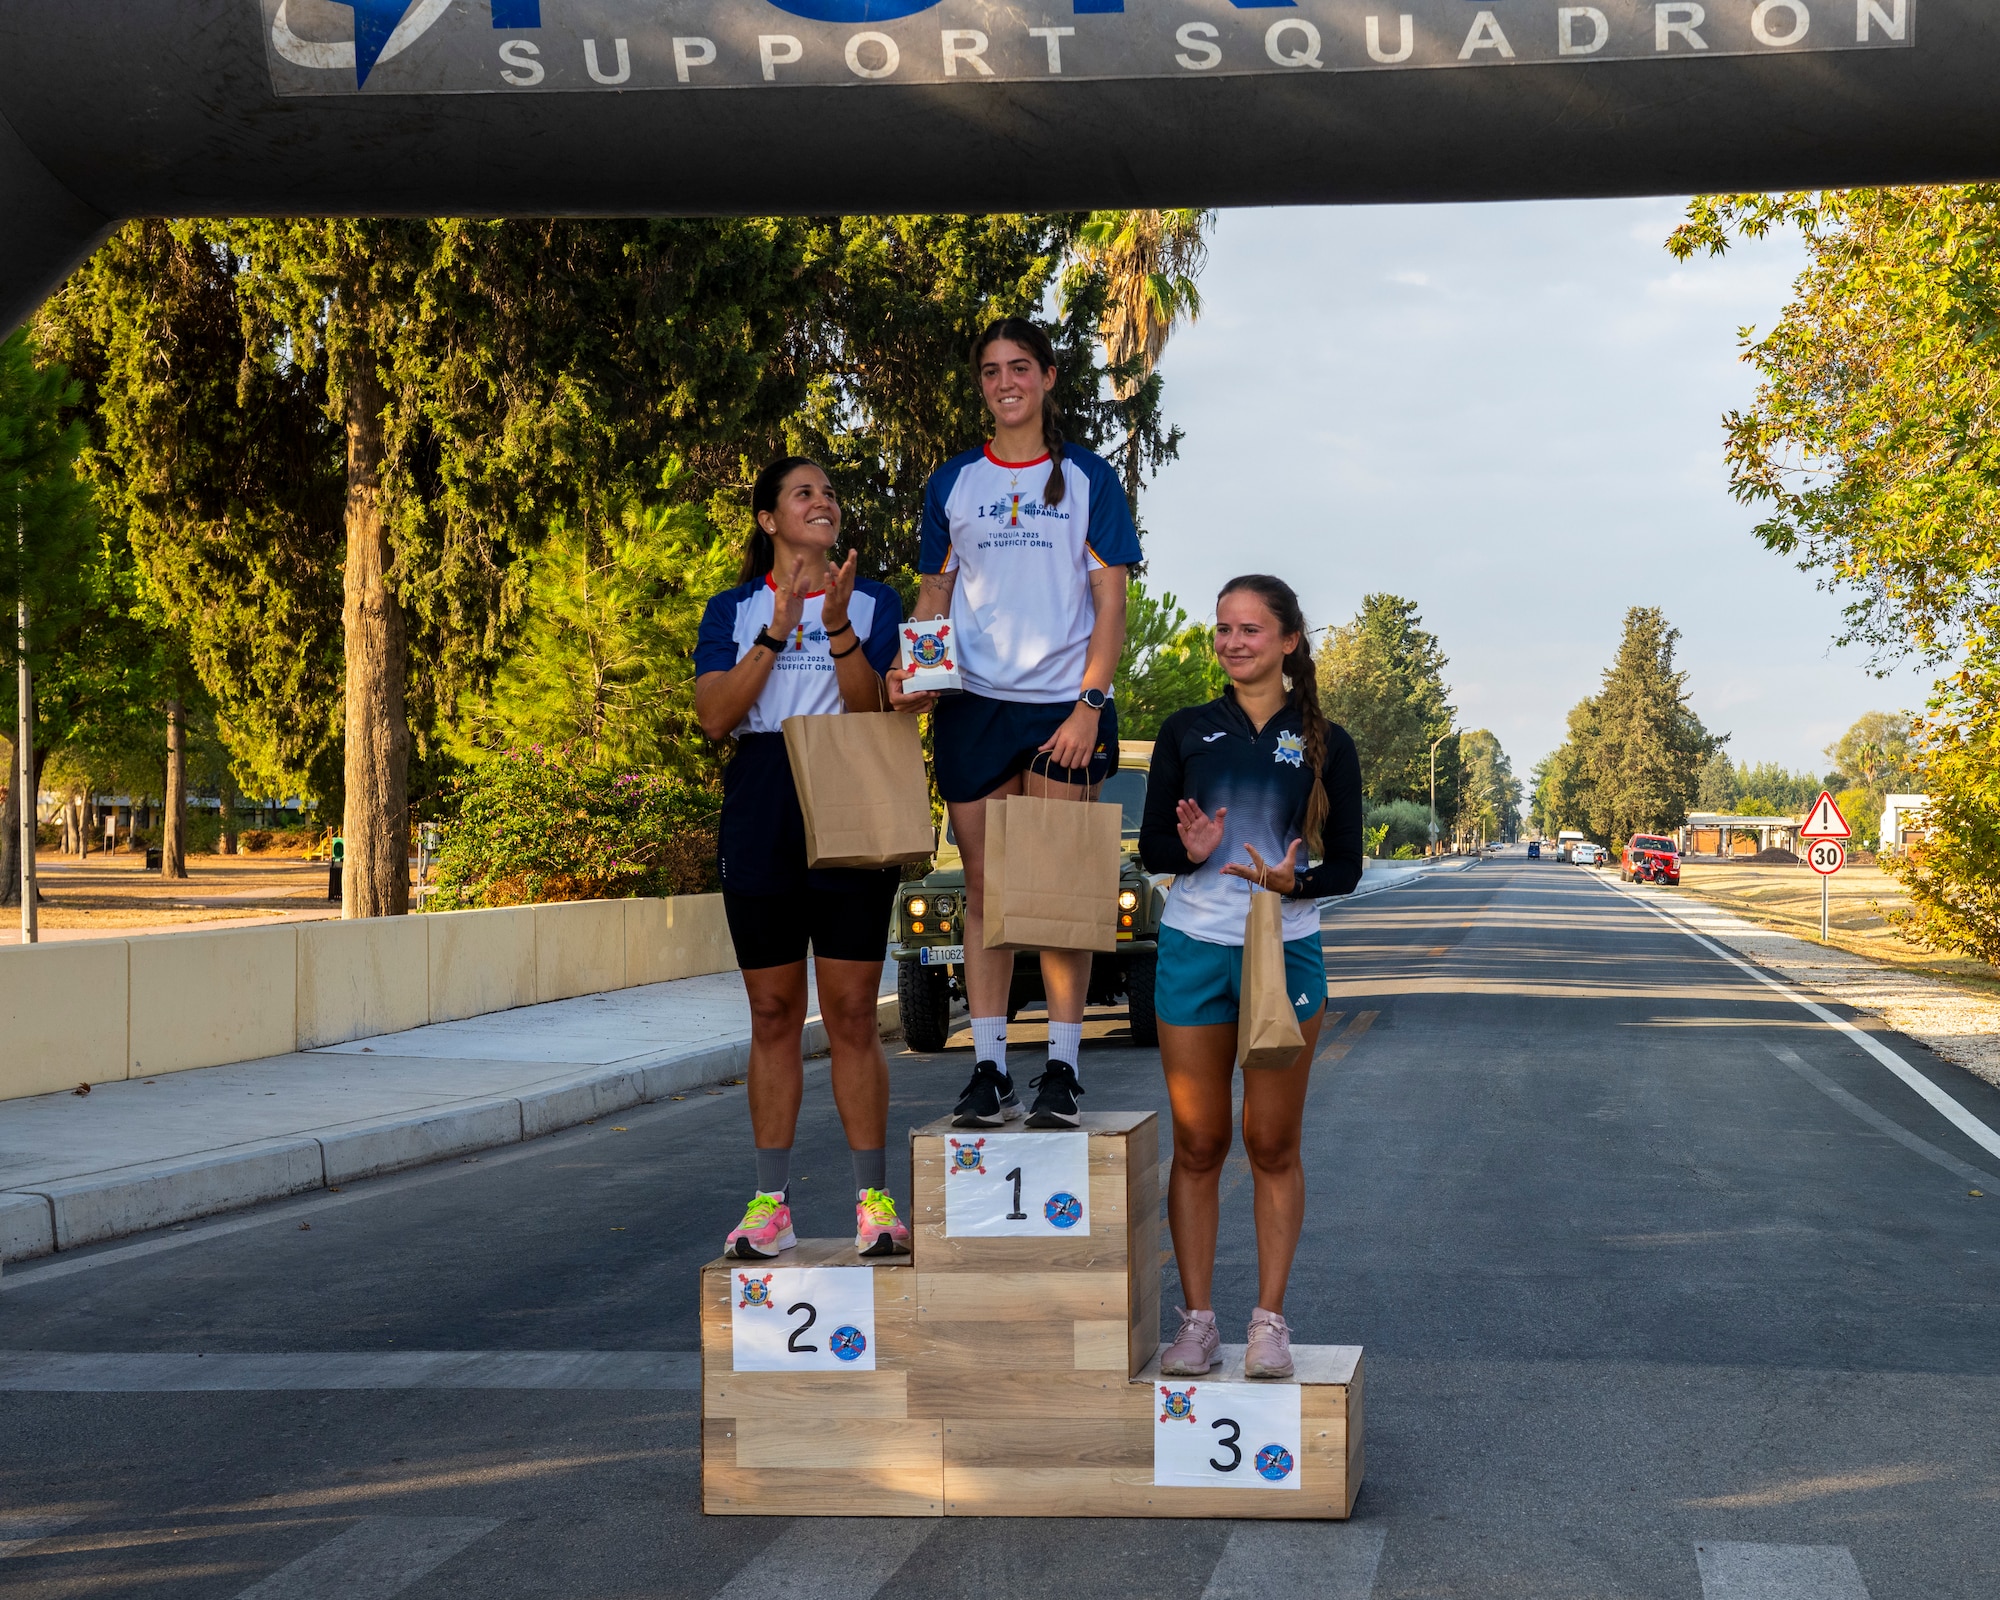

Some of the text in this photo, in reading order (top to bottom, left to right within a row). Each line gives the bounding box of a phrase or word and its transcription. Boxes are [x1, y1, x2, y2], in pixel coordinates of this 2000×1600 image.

[499, 0, 1907, 87] SUPPORT SQUADRON
[989, 531, 1019, 539] TURQUÍA
[1030, 540, 1053, 549] ORBIS
[1815, 848, 1837, 866] 30
[1005, 1167, 1028, 1220] 1
[787, 1302, 818, 1353] 2
[1209, 1418, 1242, 1472] 3
